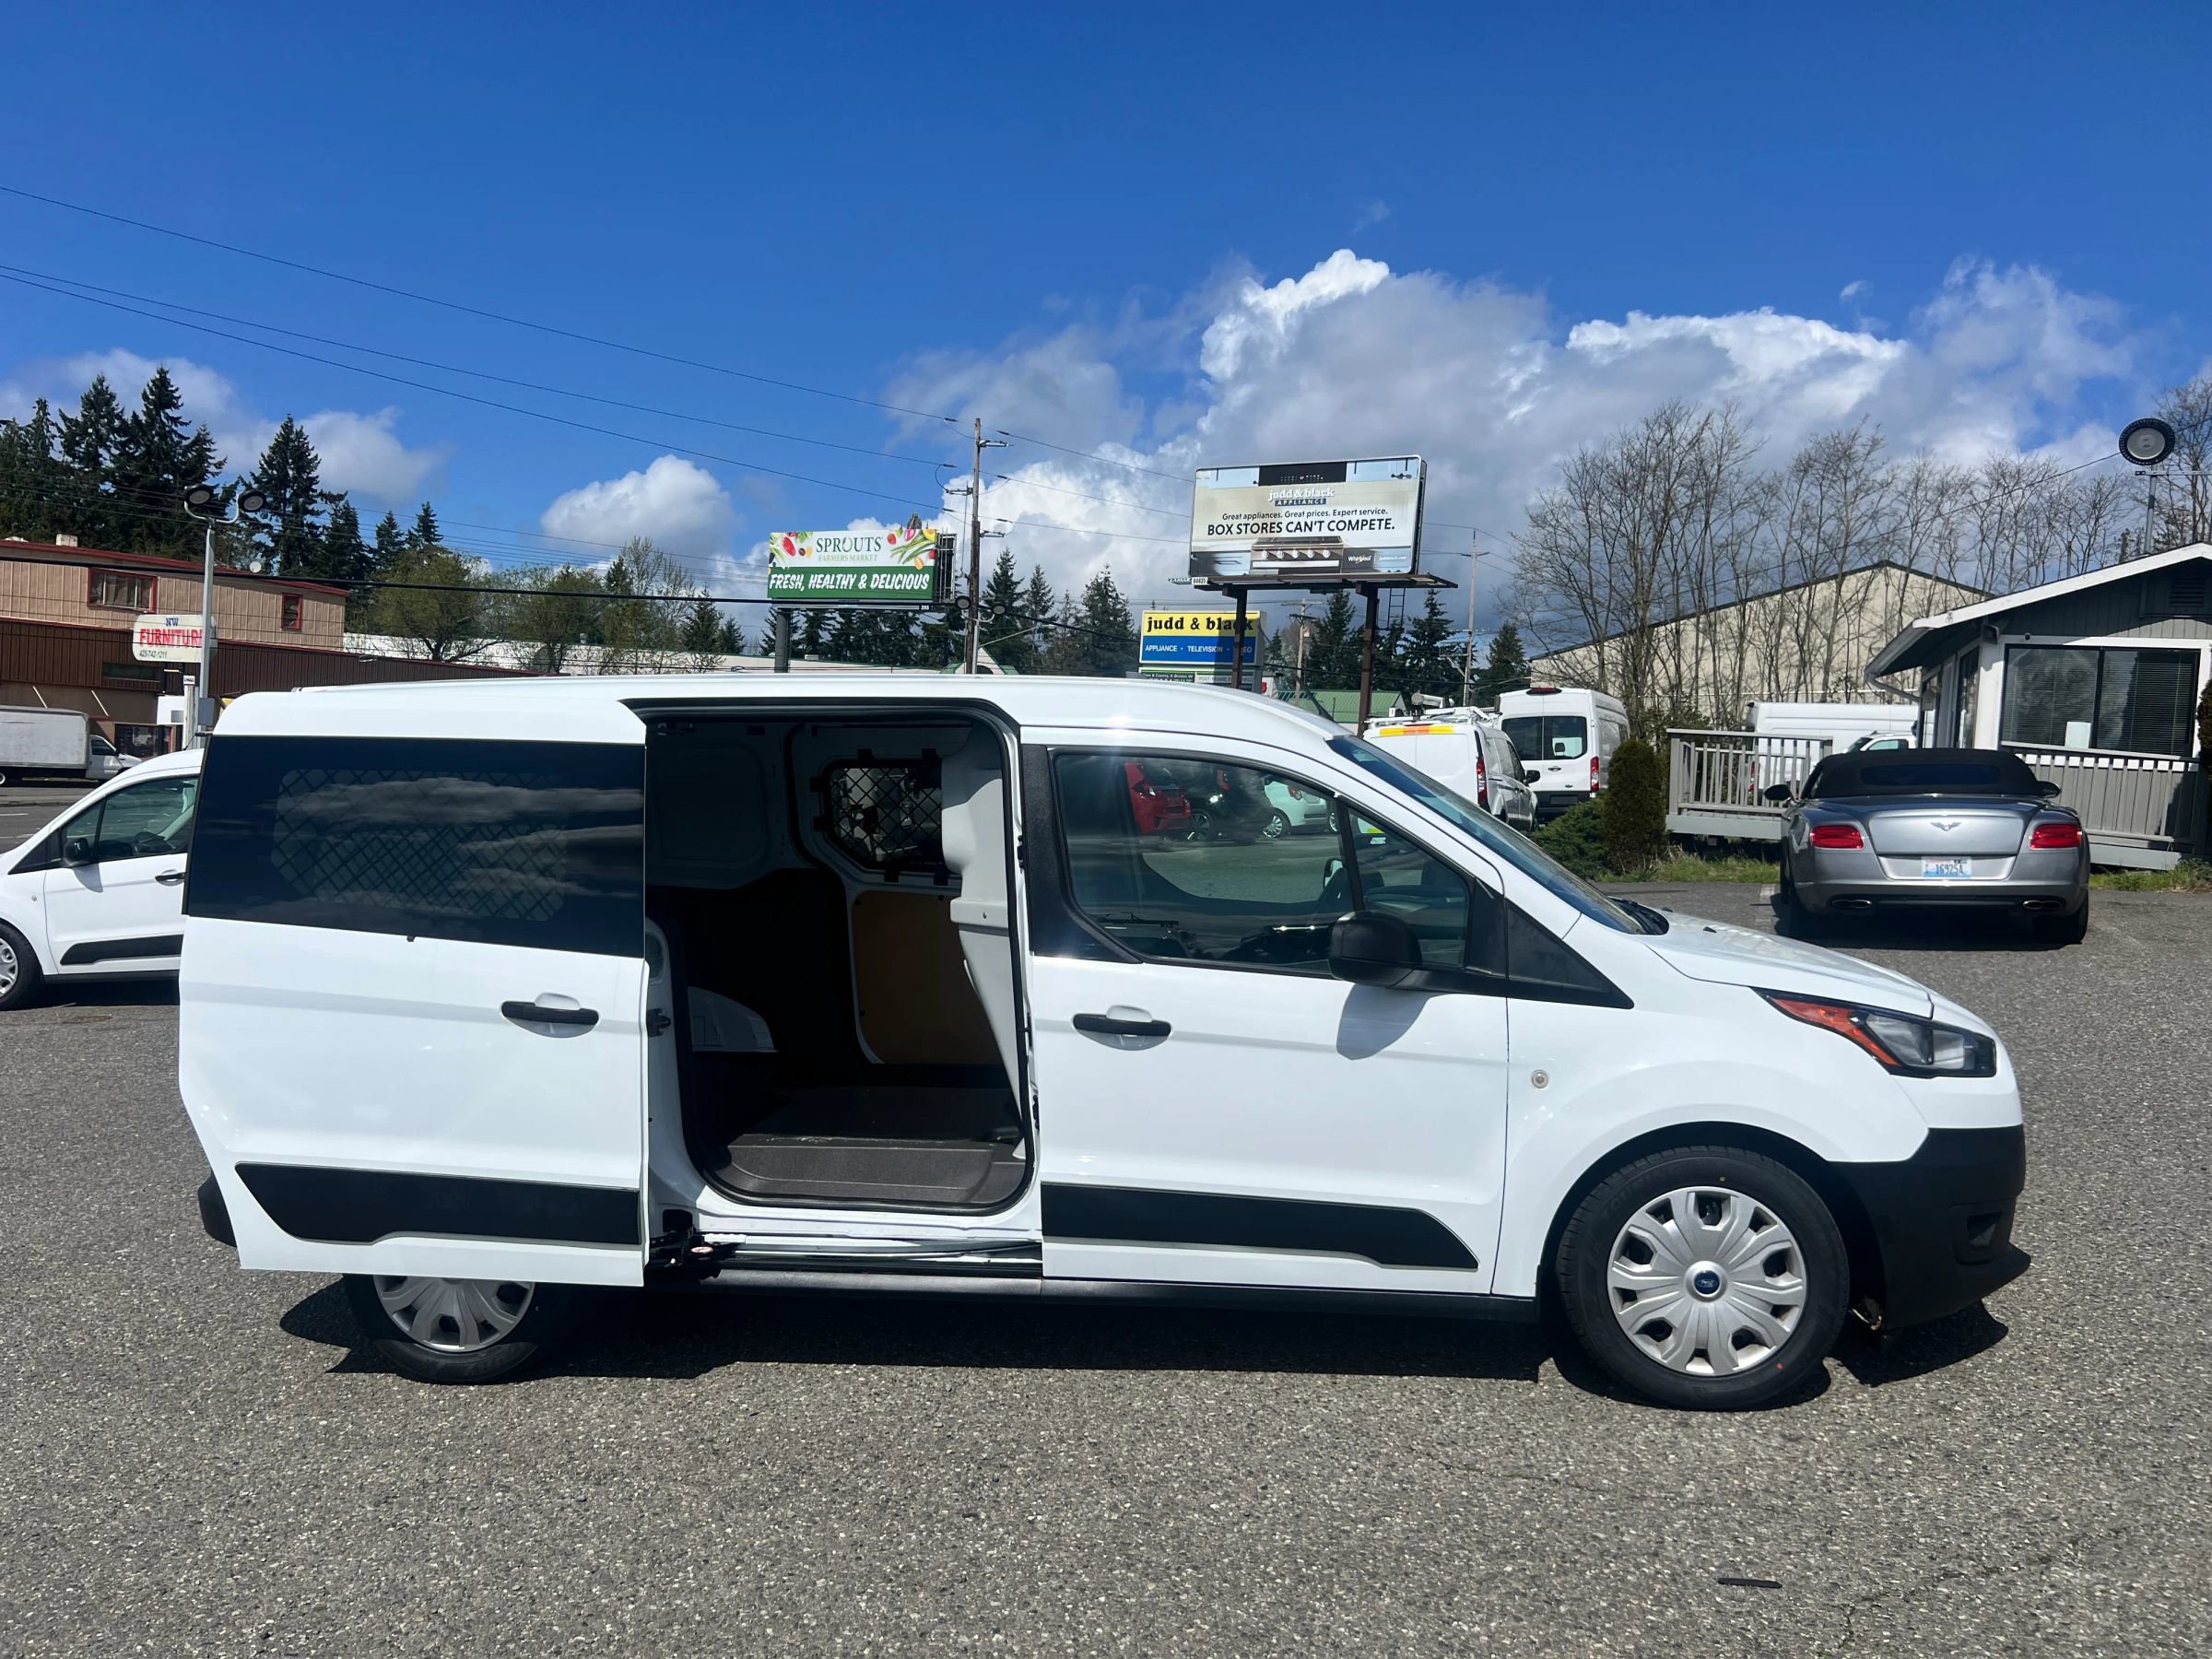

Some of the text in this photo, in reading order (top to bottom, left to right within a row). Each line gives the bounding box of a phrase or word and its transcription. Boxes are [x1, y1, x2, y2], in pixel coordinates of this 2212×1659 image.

[1268, 488, 1335, 502] judd & black
[1243, 510, 1283, 521] appliances.
[1306, 509, 1331, 519] prices.
[1333, 509, 1358, 518] Expert
[1359, 507, 1388, 515] service.
[1207, 518, 1395, 535] BOX STORES CAN'T COMPETE.
[816, 536, 881, 553] SPROUTS
[769, 573, 929, 591] FRESH, HEALTHY & DELICIOUS
[166, 618, 179, 627] NW
[1147, 618, 1184, 632] judd
[1190, 618, 1200, 630] &
